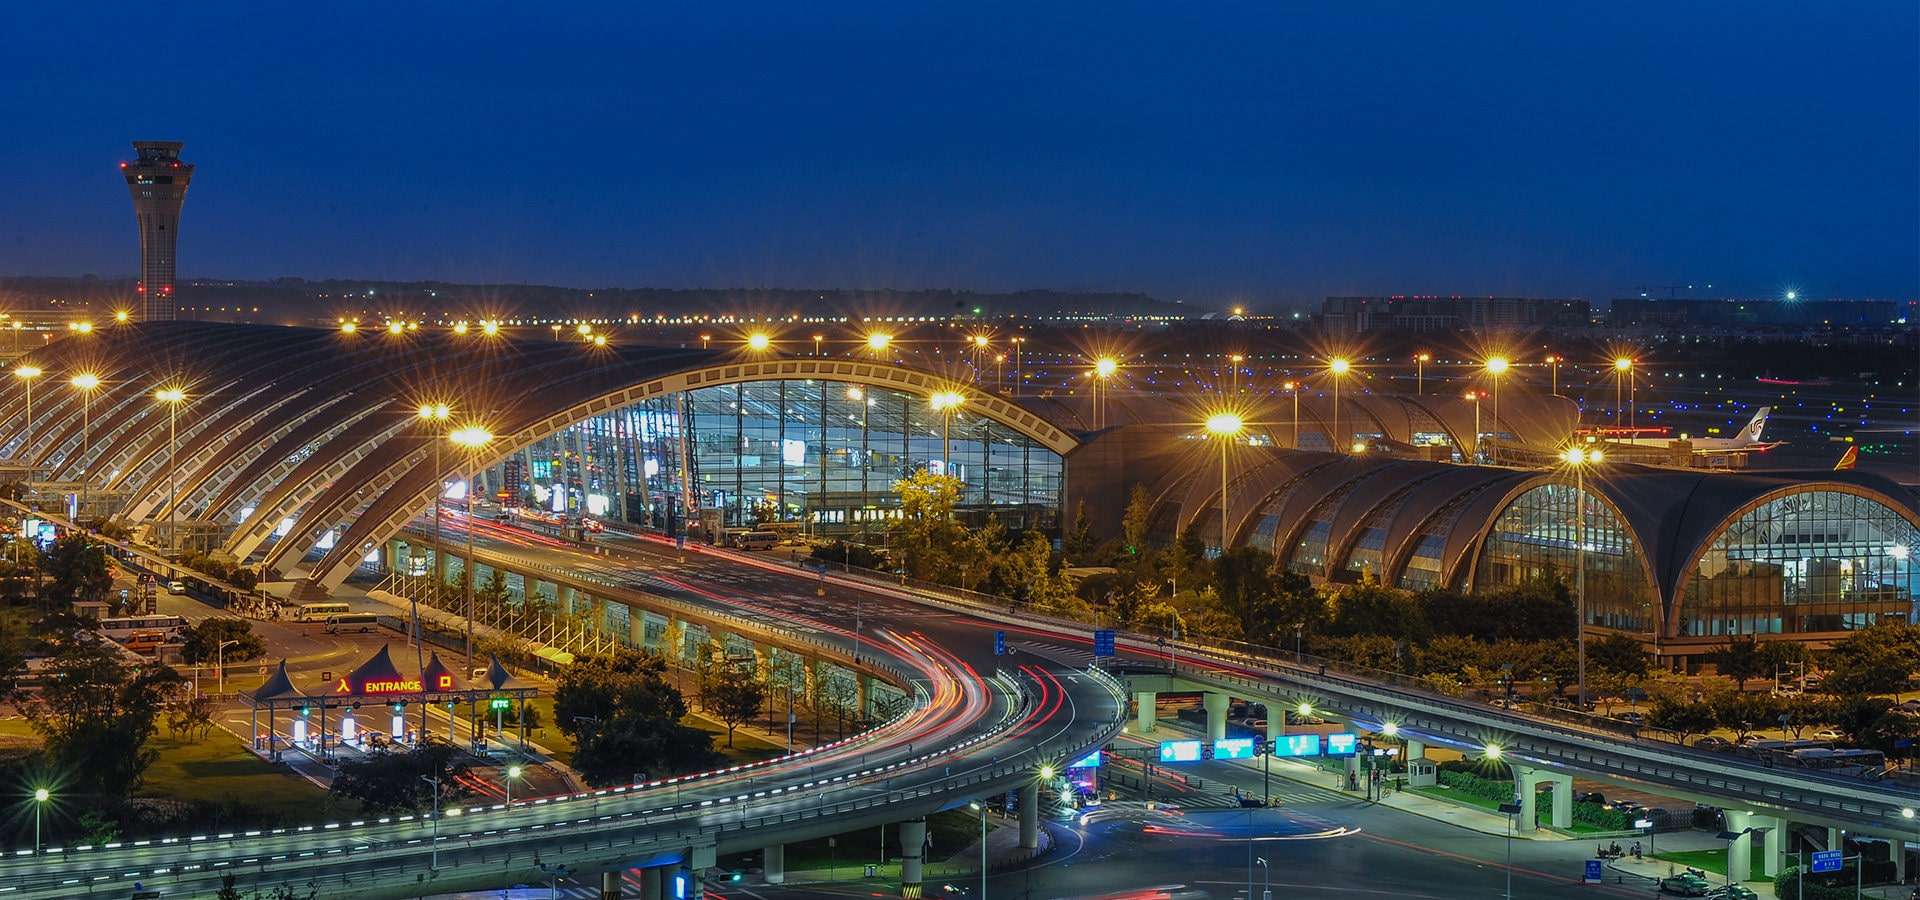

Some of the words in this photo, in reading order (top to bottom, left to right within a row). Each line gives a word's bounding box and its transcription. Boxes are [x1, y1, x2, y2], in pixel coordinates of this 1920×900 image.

[336, 678, 350, 693] 入
[365, 680, 422, 692] ENTRANCE
[439, 676, 452, 688] 口
